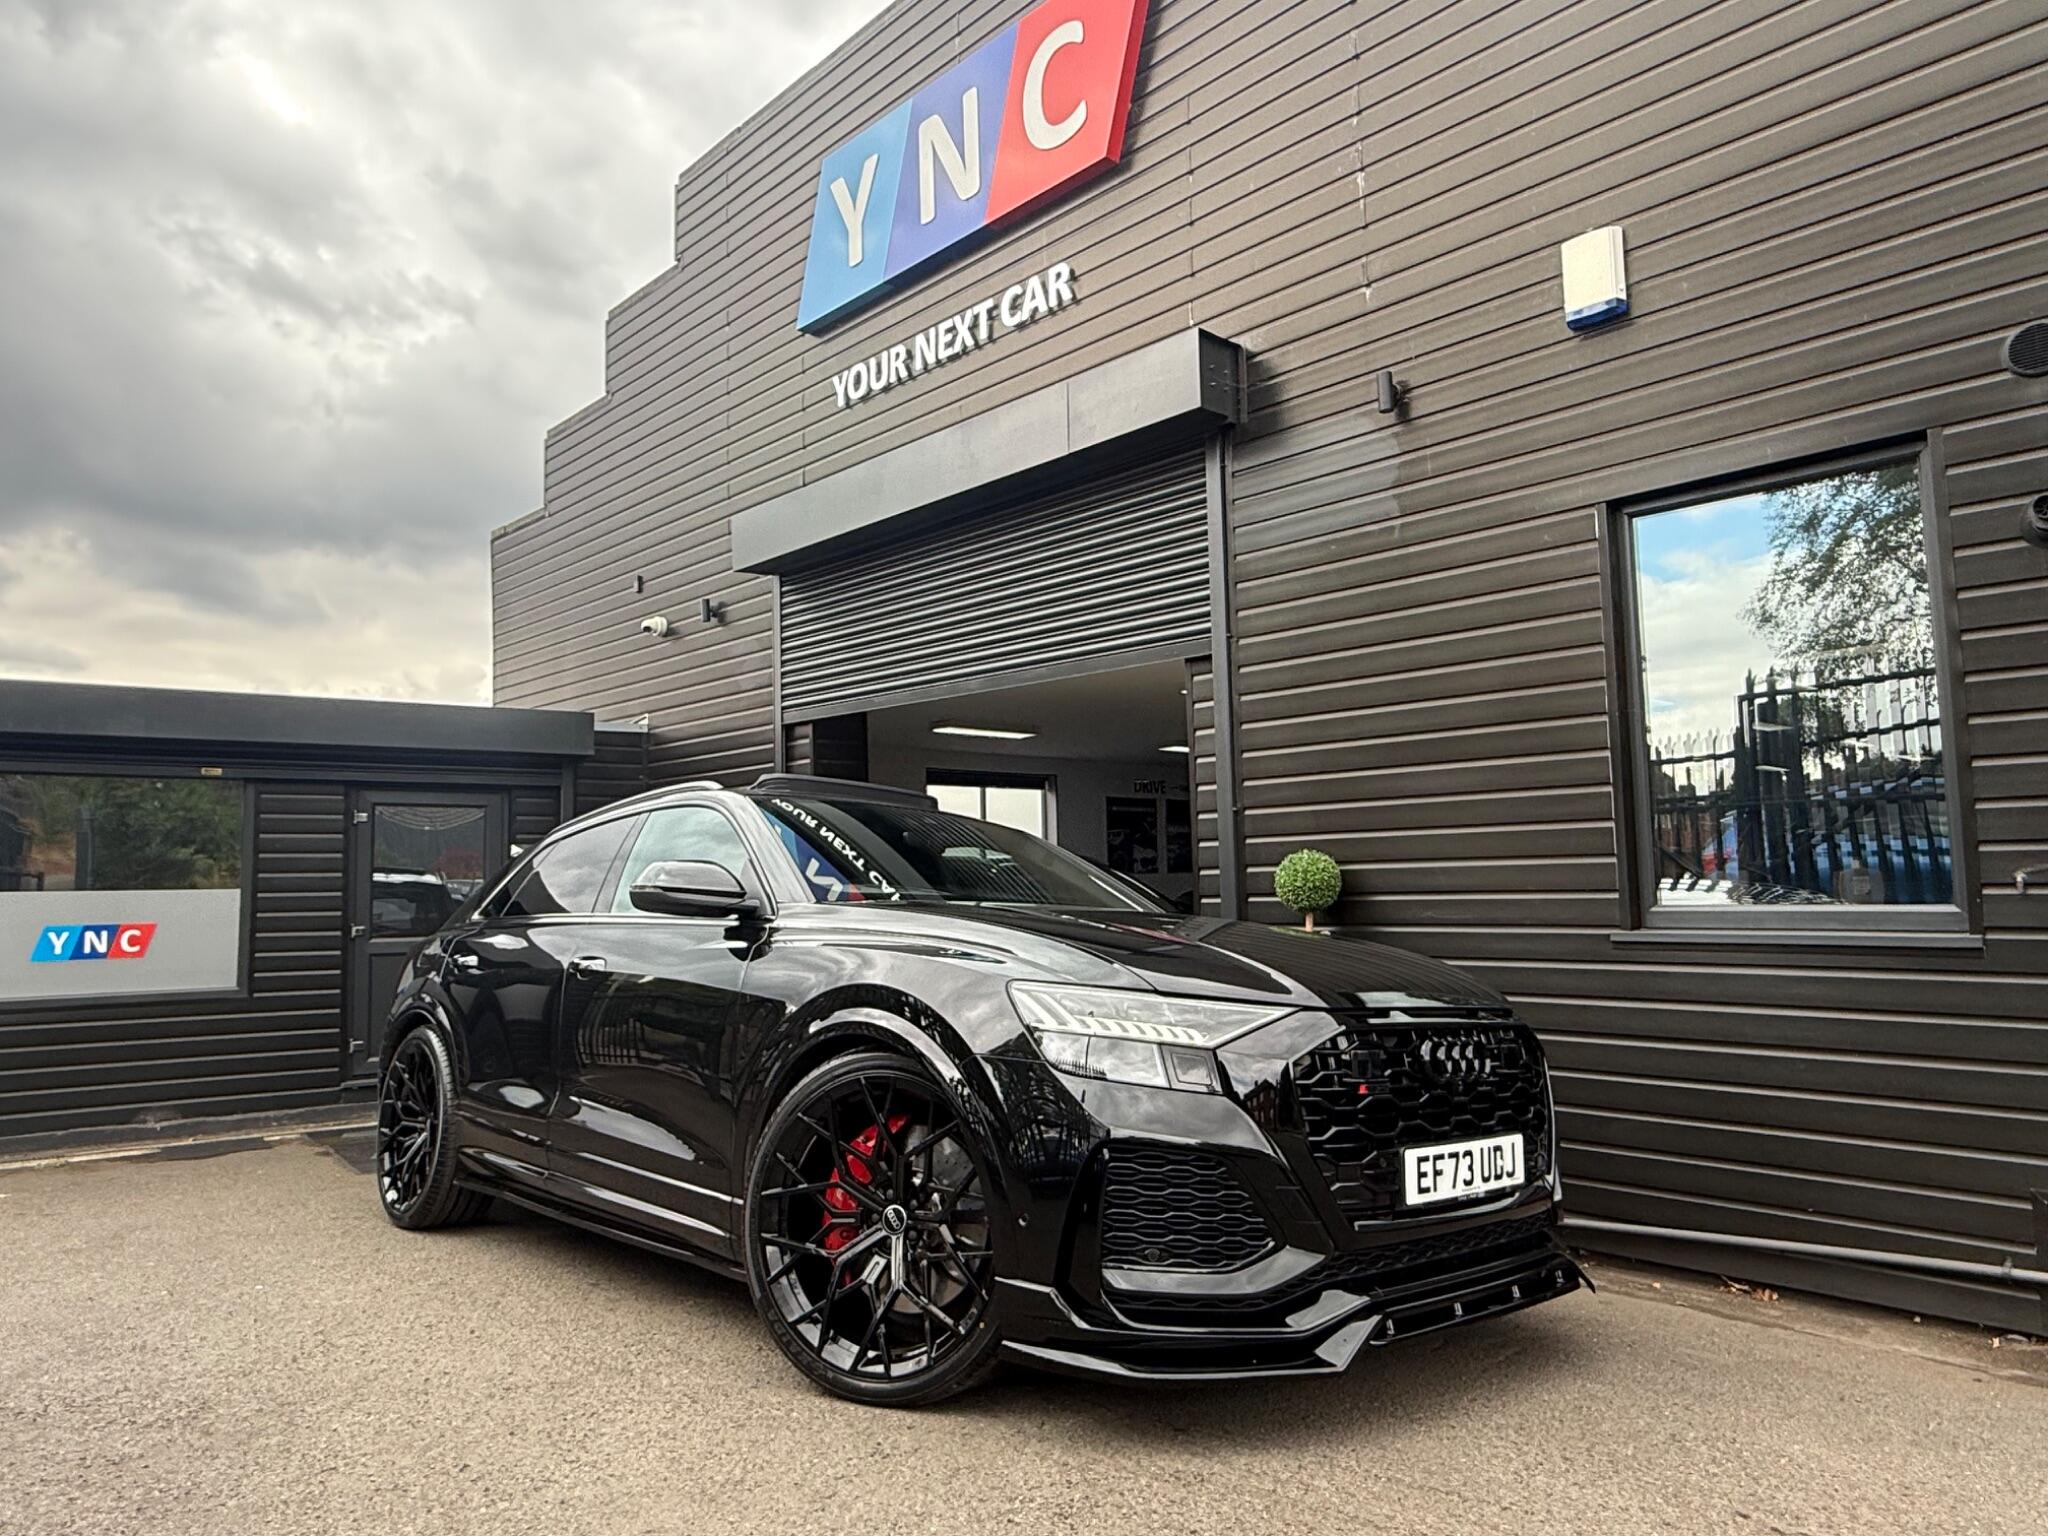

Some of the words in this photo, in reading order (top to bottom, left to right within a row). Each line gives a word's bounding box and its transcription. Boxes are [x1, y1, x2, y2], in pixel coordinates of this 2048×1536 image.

[830, 19, 1087, 267] YNC
[831, 344, 908, 407] YOUR
[913, 299, 996, 372] NEXT
[1000, 262, 1075, 327] CAR
[48, 929, 141, 955] YNC
[1417, 1149, 1474, 1195] EF73
[1480, 1142, 1516, 1183] UDJ
